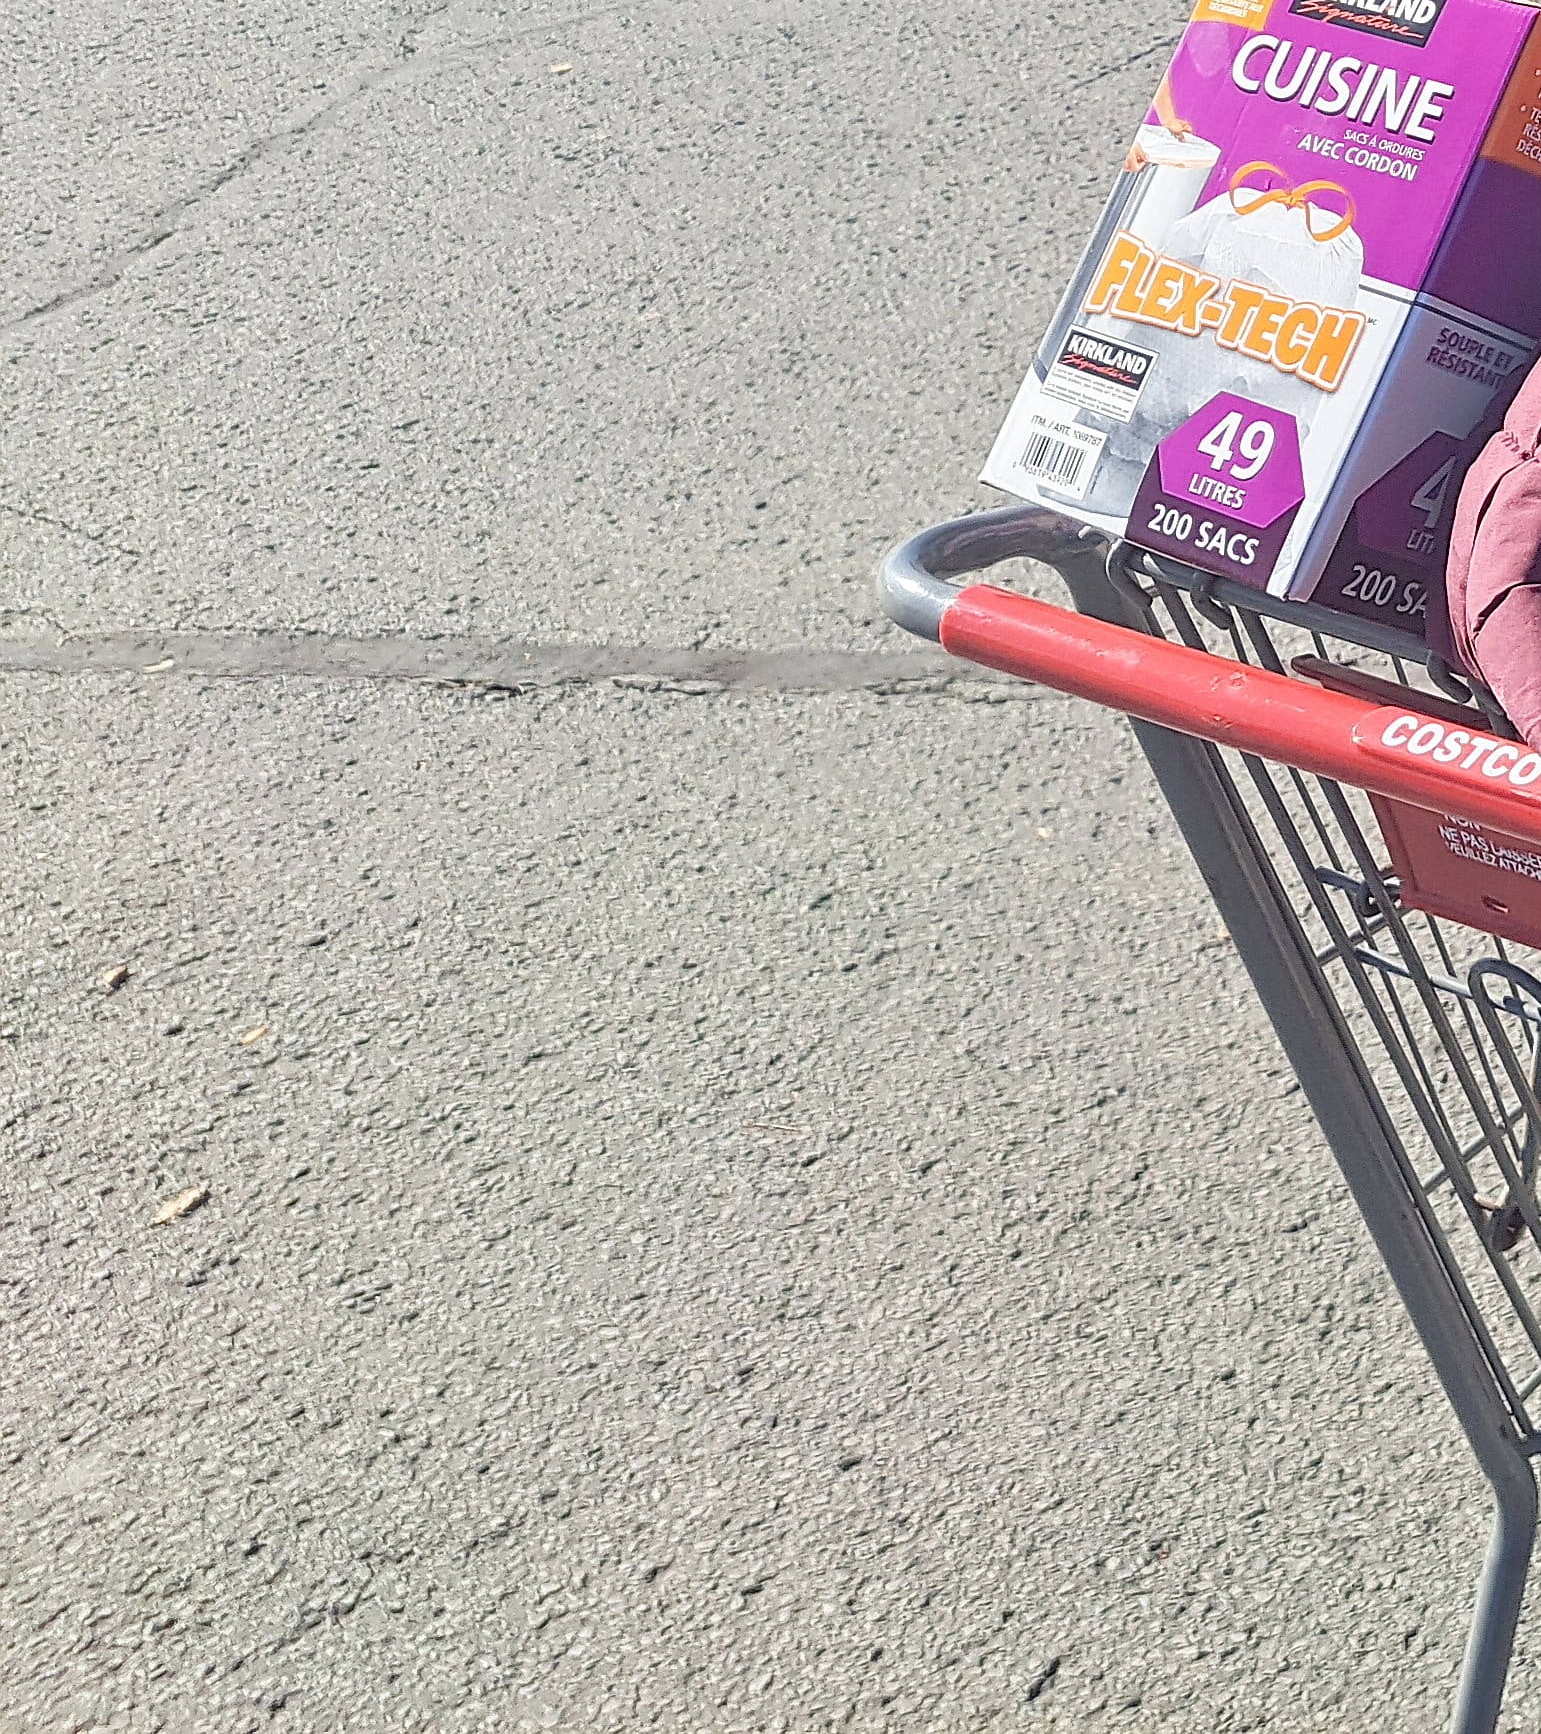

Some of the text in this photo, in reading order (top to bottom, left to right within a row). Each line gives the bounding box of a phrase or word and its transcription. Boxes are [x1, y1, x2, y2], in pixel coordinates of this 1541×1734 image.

[1231, 33, 1455, 145] CUISINE
[1297, 133, 1418, 182] AVEC CORDON
[1343, 128, 1369, 147] SACS
[1378, 138, 1426, 161] ORDURES
[1087, 233, 1364, 388] FLEX-TECH
[1067, 334, 1147, 375] KIRKLAND
[1436, 326, 1495, 363] SOUPLE
[1197, 411, 1275, 482] 49
[1187, 473, 1247, 509] LITRES
[1147, 503, 1260, 565] 200 SACS
[1341, 564, 1398, 607] 200
[1439, 826, 1459, 842] NE
[1460, 831, 1490, 852] PAS
